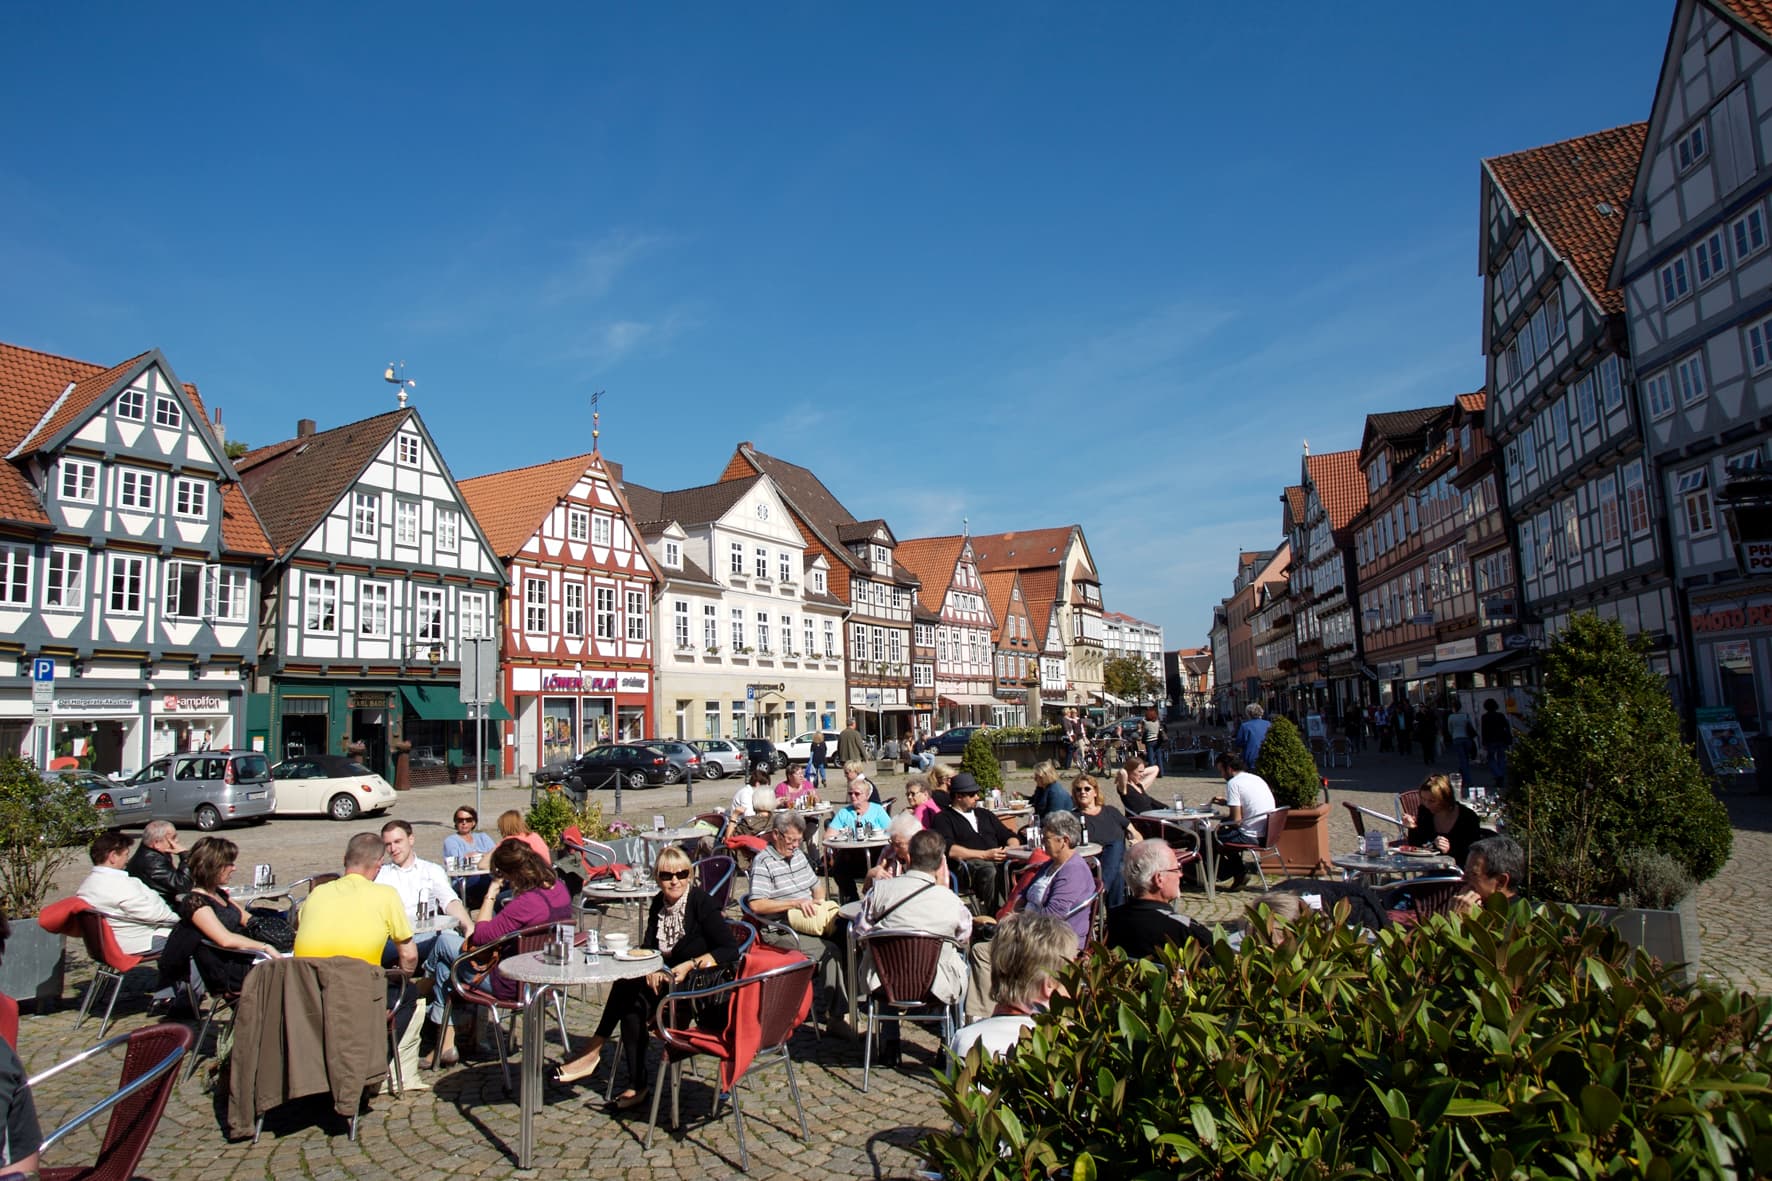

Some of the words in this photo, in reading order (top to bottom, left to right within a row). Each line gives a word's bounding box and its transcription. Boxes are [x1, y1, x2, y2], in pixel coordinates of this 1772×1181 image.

[1749, 543, 1772, 556] PH
[1691, 608, 1744, 633] PHOTO
[39, 661, 51, 679] P
[543, 673, 583, 690] LÖWEN
